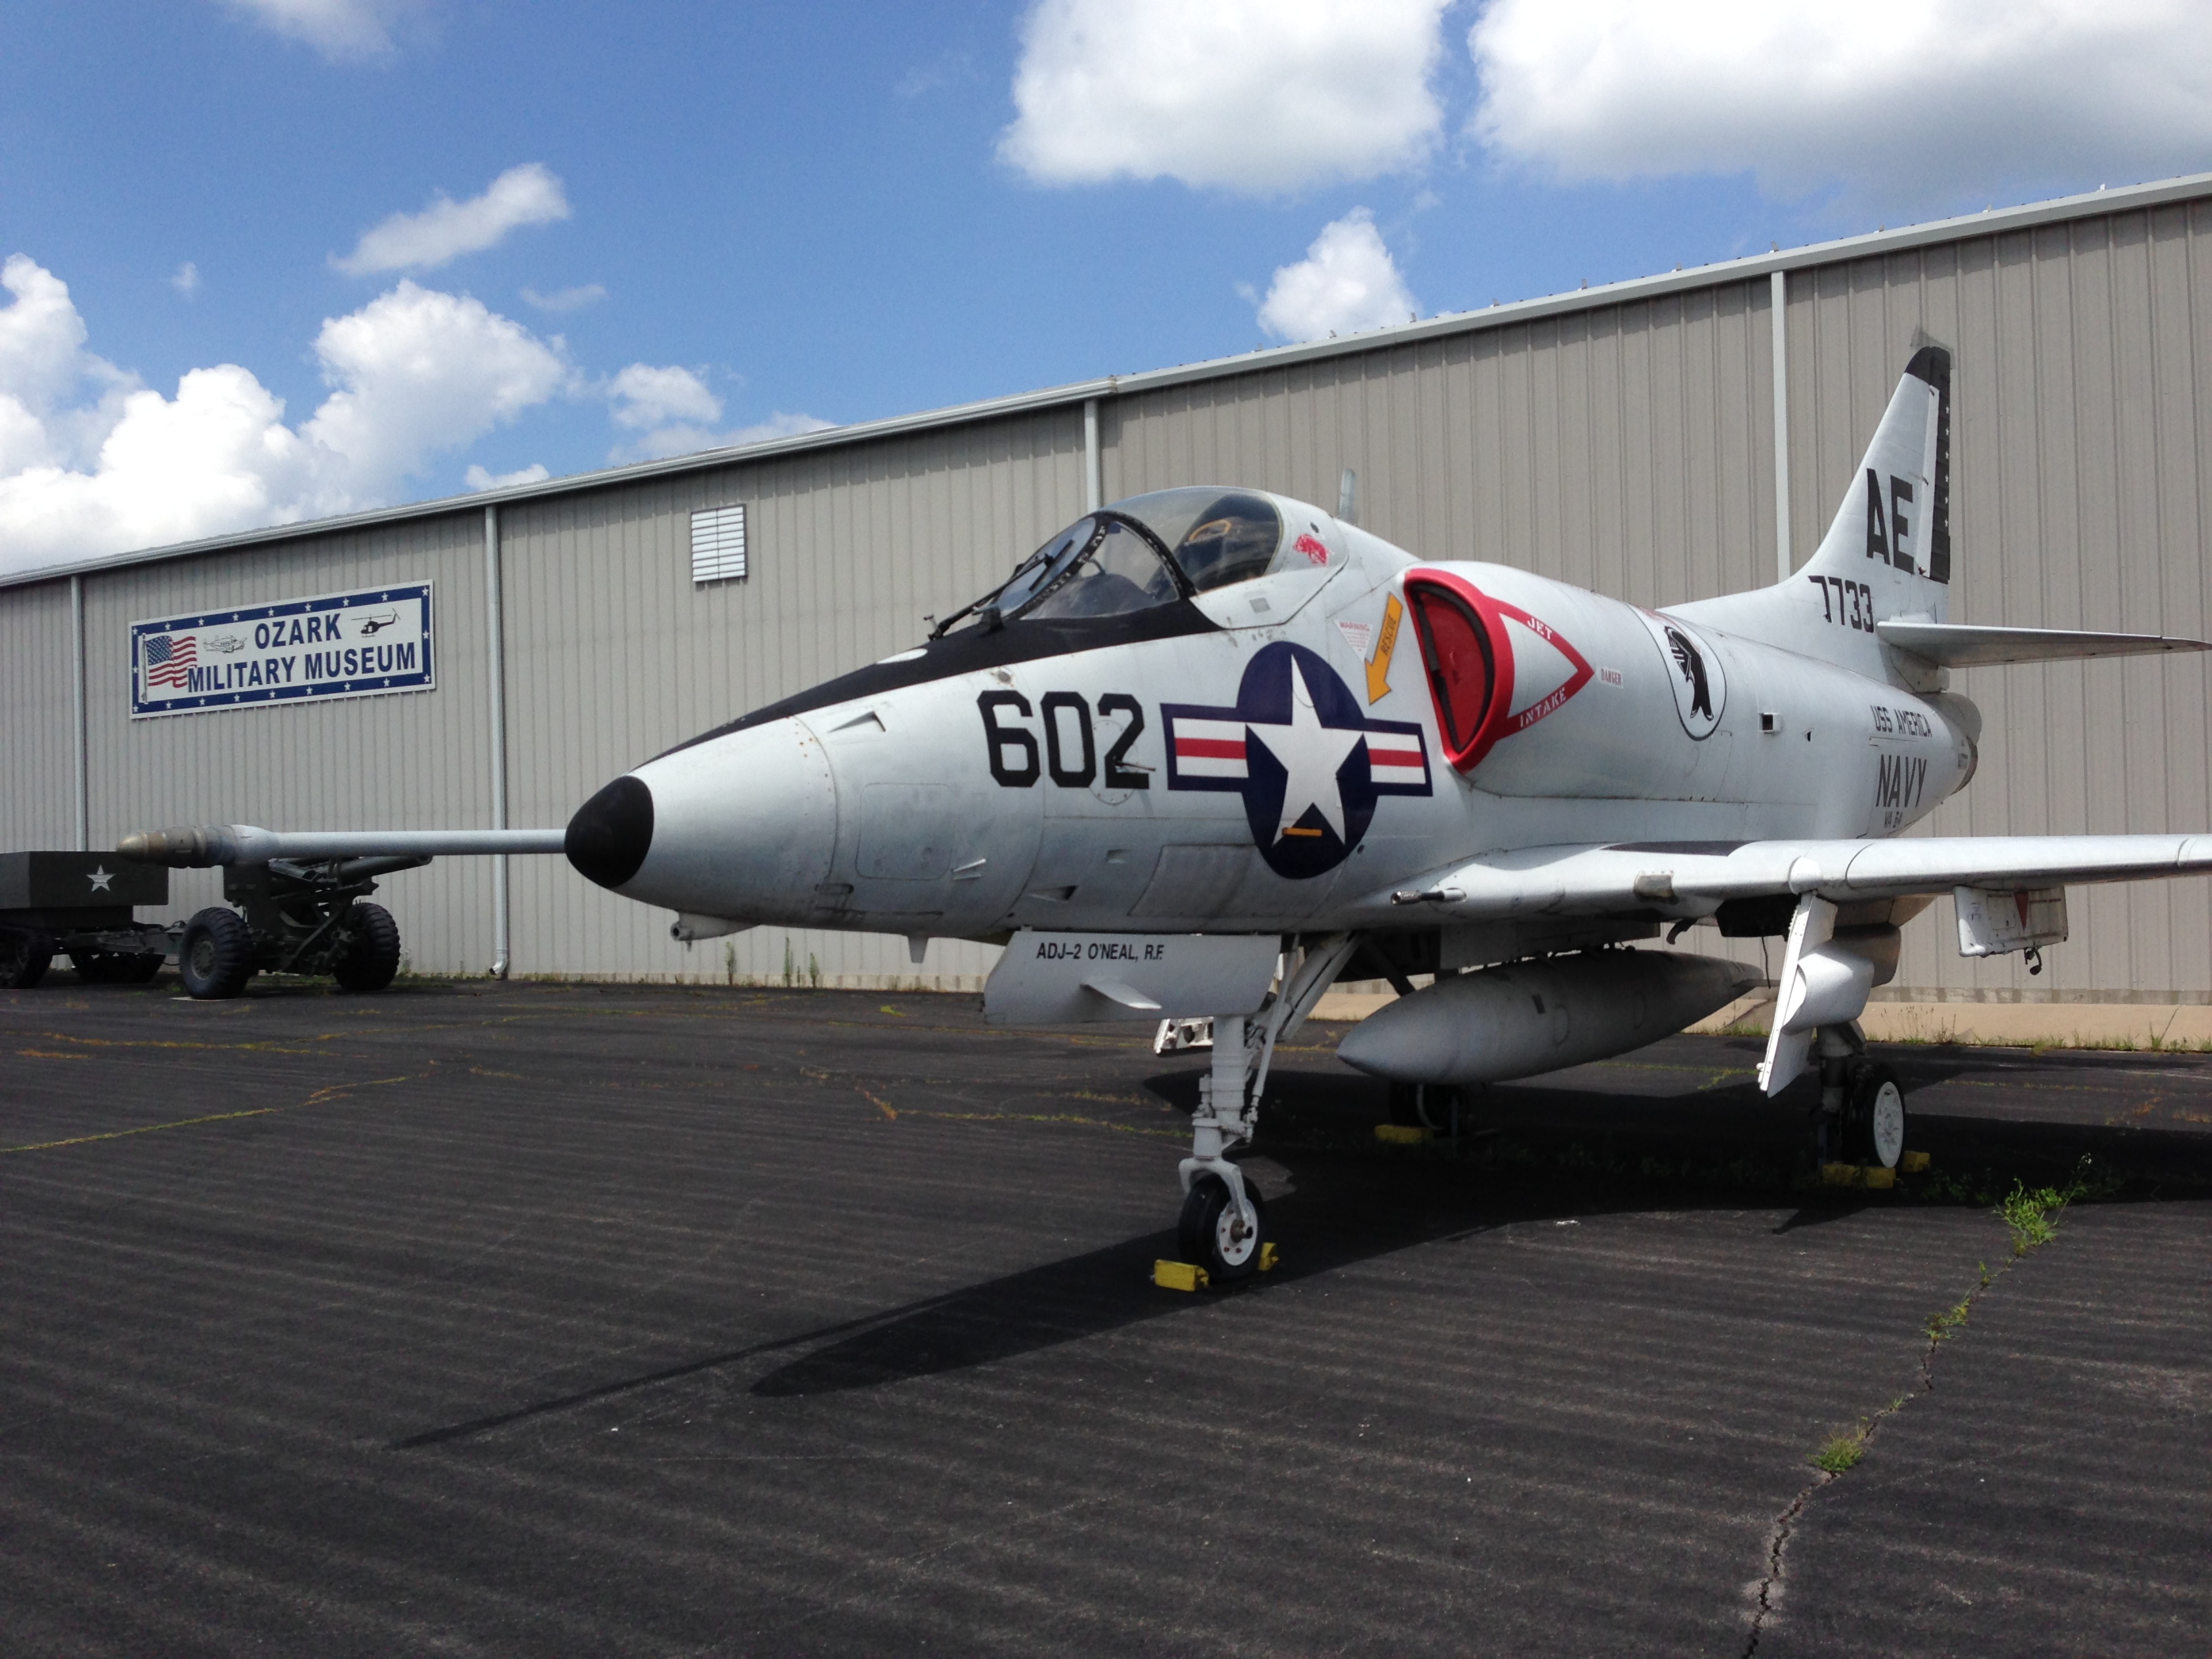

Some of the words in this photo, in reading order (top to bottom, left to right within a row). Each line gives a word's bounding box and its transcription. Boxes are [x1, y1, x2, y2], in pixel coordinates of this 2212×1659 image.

[1866, 468, 1914, 575] AE
[1807, 575, 1874, 633] 7733
[255, 613, 342, 650] OZARK
[1380, 613, 1396, 656] RESCUE
[1527, 617, 1553, 640] JET
[188, 656, 296, 693] MILITARY
[304, 642, 415, 680] MUSEUM
[1520, 687, 1566, 727] INTAKE
[1870, 705, 1893, 733] USS
[1893, 708, 1933, 738] AMERICA
[977, 691, 1150, 790] 602
[1876, 754, 1927, 808] NAVY
[1036, 942, 1082, 959] ADJ-2
